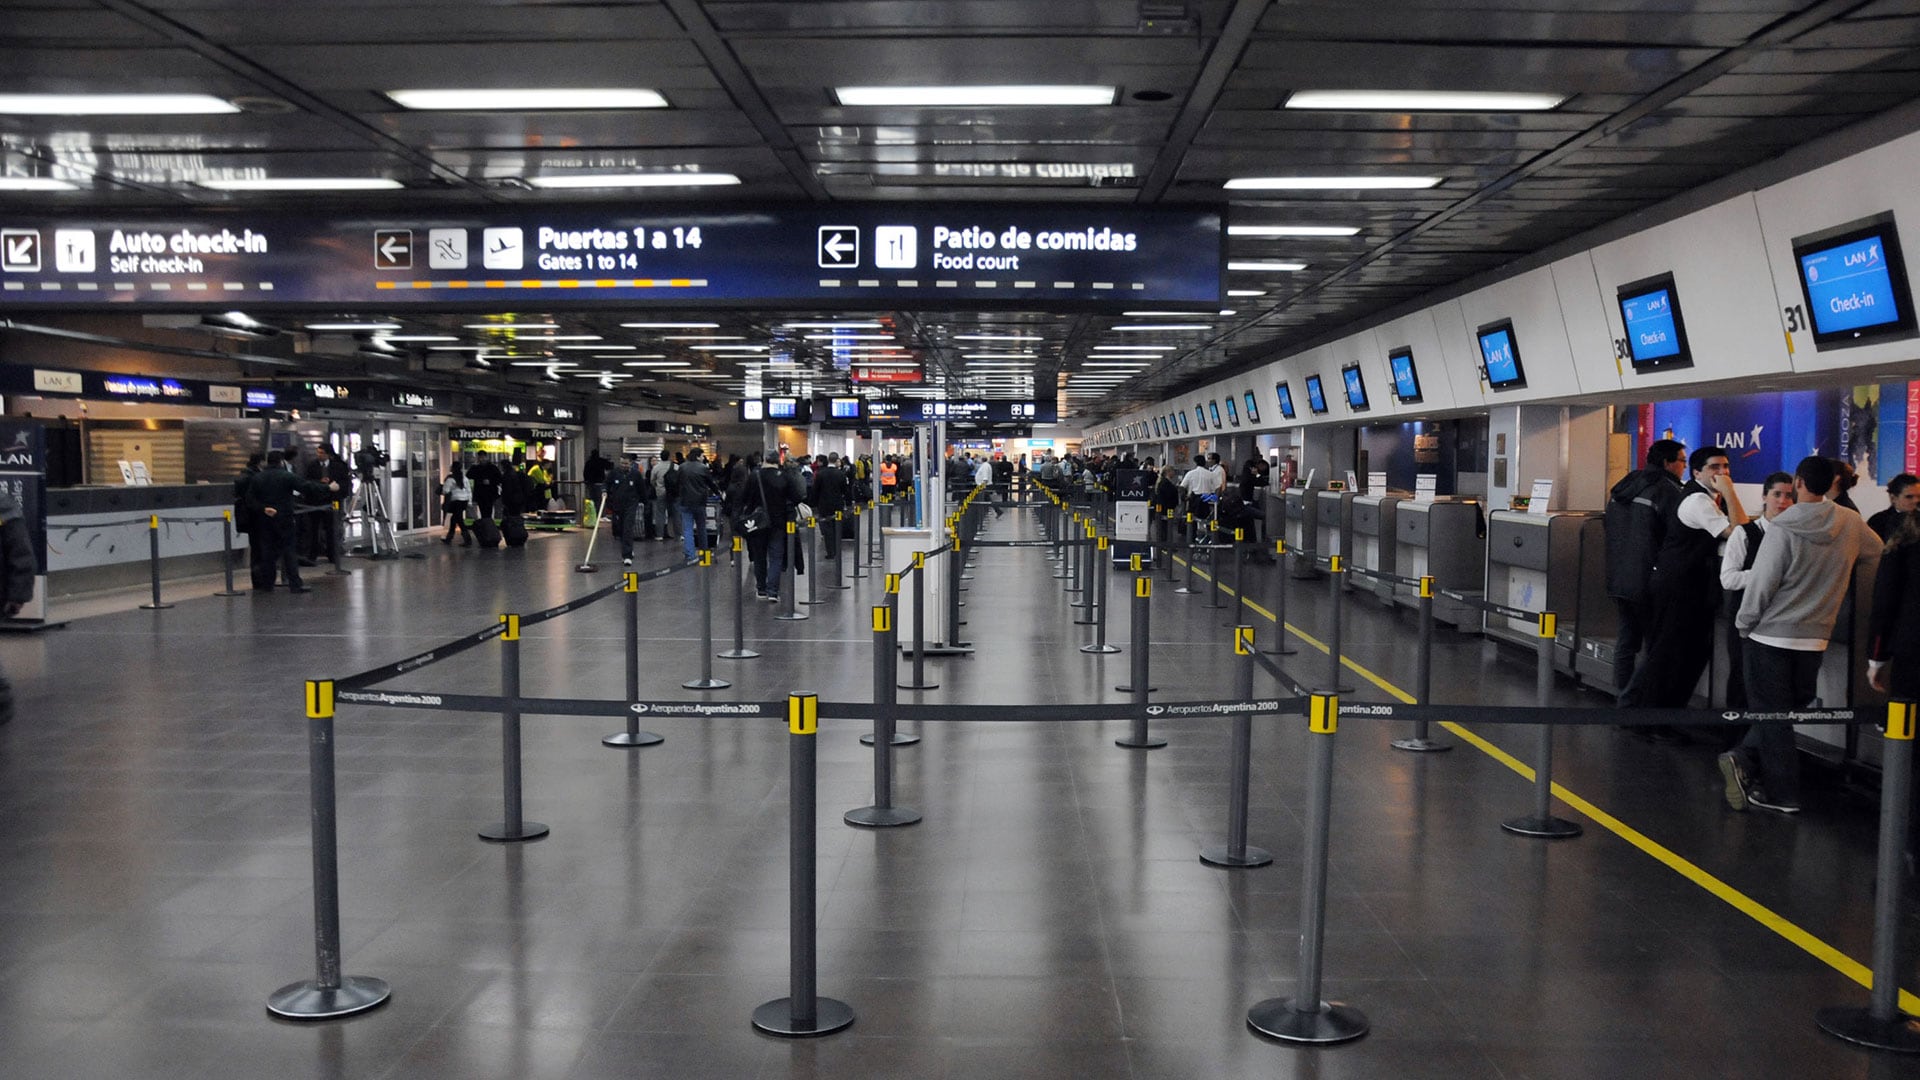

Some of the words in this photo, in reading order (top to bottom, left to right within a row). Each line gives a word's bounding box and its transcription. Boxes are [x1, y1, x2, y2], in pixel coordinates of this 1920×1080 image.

[110, 229, 166, 253] Auto
[170, 228, 267, 253] check-in
[538, 227, 628, 249] Puertas
[633, 227, 645, 249] 1
[651, 231, 667, 249] a
[673, 227, 702, 249] 14
[934, 226, 996, 249] Patio
[1000, 226, 1032, 249] de
[1036, 226, 1136, 251] comidas
[110, 255, 140, 273] Self
[141, 255, 203, 273] check-in
[538, 253, 582, 270] Gates
[586, 253, 594, 270] 1
[598, 255, 616, 270] to
[619, 253, 638, 270] 14
[934, 252, 973, 269] Food
[976, 255, 1019, 270] court
[1844, 250, 1867, 266] LAN
[1646, 300, 1661, 311] LAN
[1830, 291, 1875, 313] Check-in
[1785, 304, 1806, 333] 31
[1640, 330, 1667, 346] Check-in
[1486, 349, 1503, 364] LAN
[1615, 338, 1632, 359] 30
[43, 377, 62, 386] LAN
[460, 429, 501, 438] TrueStar
[1841, 394, 1851, 465] ENDOZA
[1716, 432, 1744, 448] LAN
[0, 454, 33, 465] LAN
[338, 691, 379, 702] Aeropuertos
[380, 693, 421, 705] Argentina
[421, 695, 442, 705] 2000
[650, 704, 694, 714] Aeropuertos
[694, 704, 738, 715] Argentina
[739, 705, 760, 713] 2000
[1167, 705, 1212, 715] Aeropuertos
[1212, 702, 1257, 714] Argentina
[1257, 702, 1278, 711] 2000
[1371, 706, 1393, 715] 2000
[1743, 711, 1788, 721] Aeropuertos
[1788, 710, 1832, 722] Argentina
[1832, 711, 1854, 719] 2000
